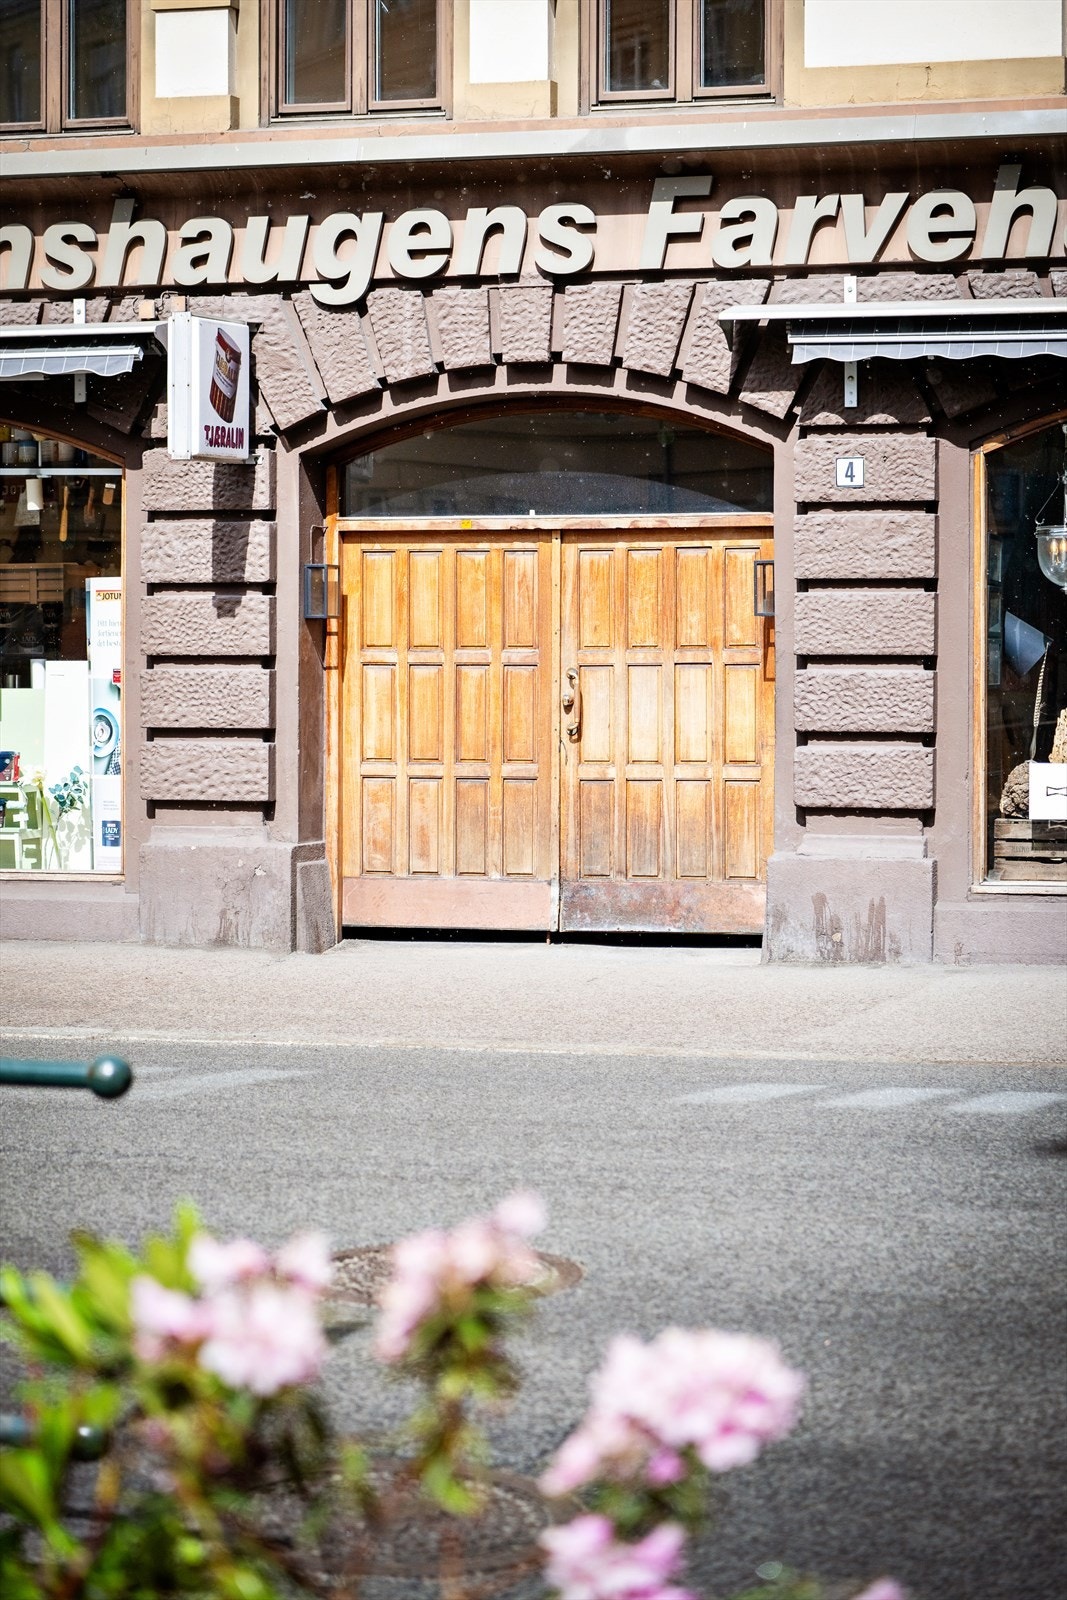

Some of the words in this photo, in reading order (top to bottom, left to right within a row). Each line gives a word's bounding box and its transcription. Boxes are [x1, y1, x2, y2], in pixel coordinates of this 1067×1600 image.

[639, 164, 1067, 268] Farveh
[203, 424, 245, 450] TJÆRALIN
[844, 461, 856, 483] 4
